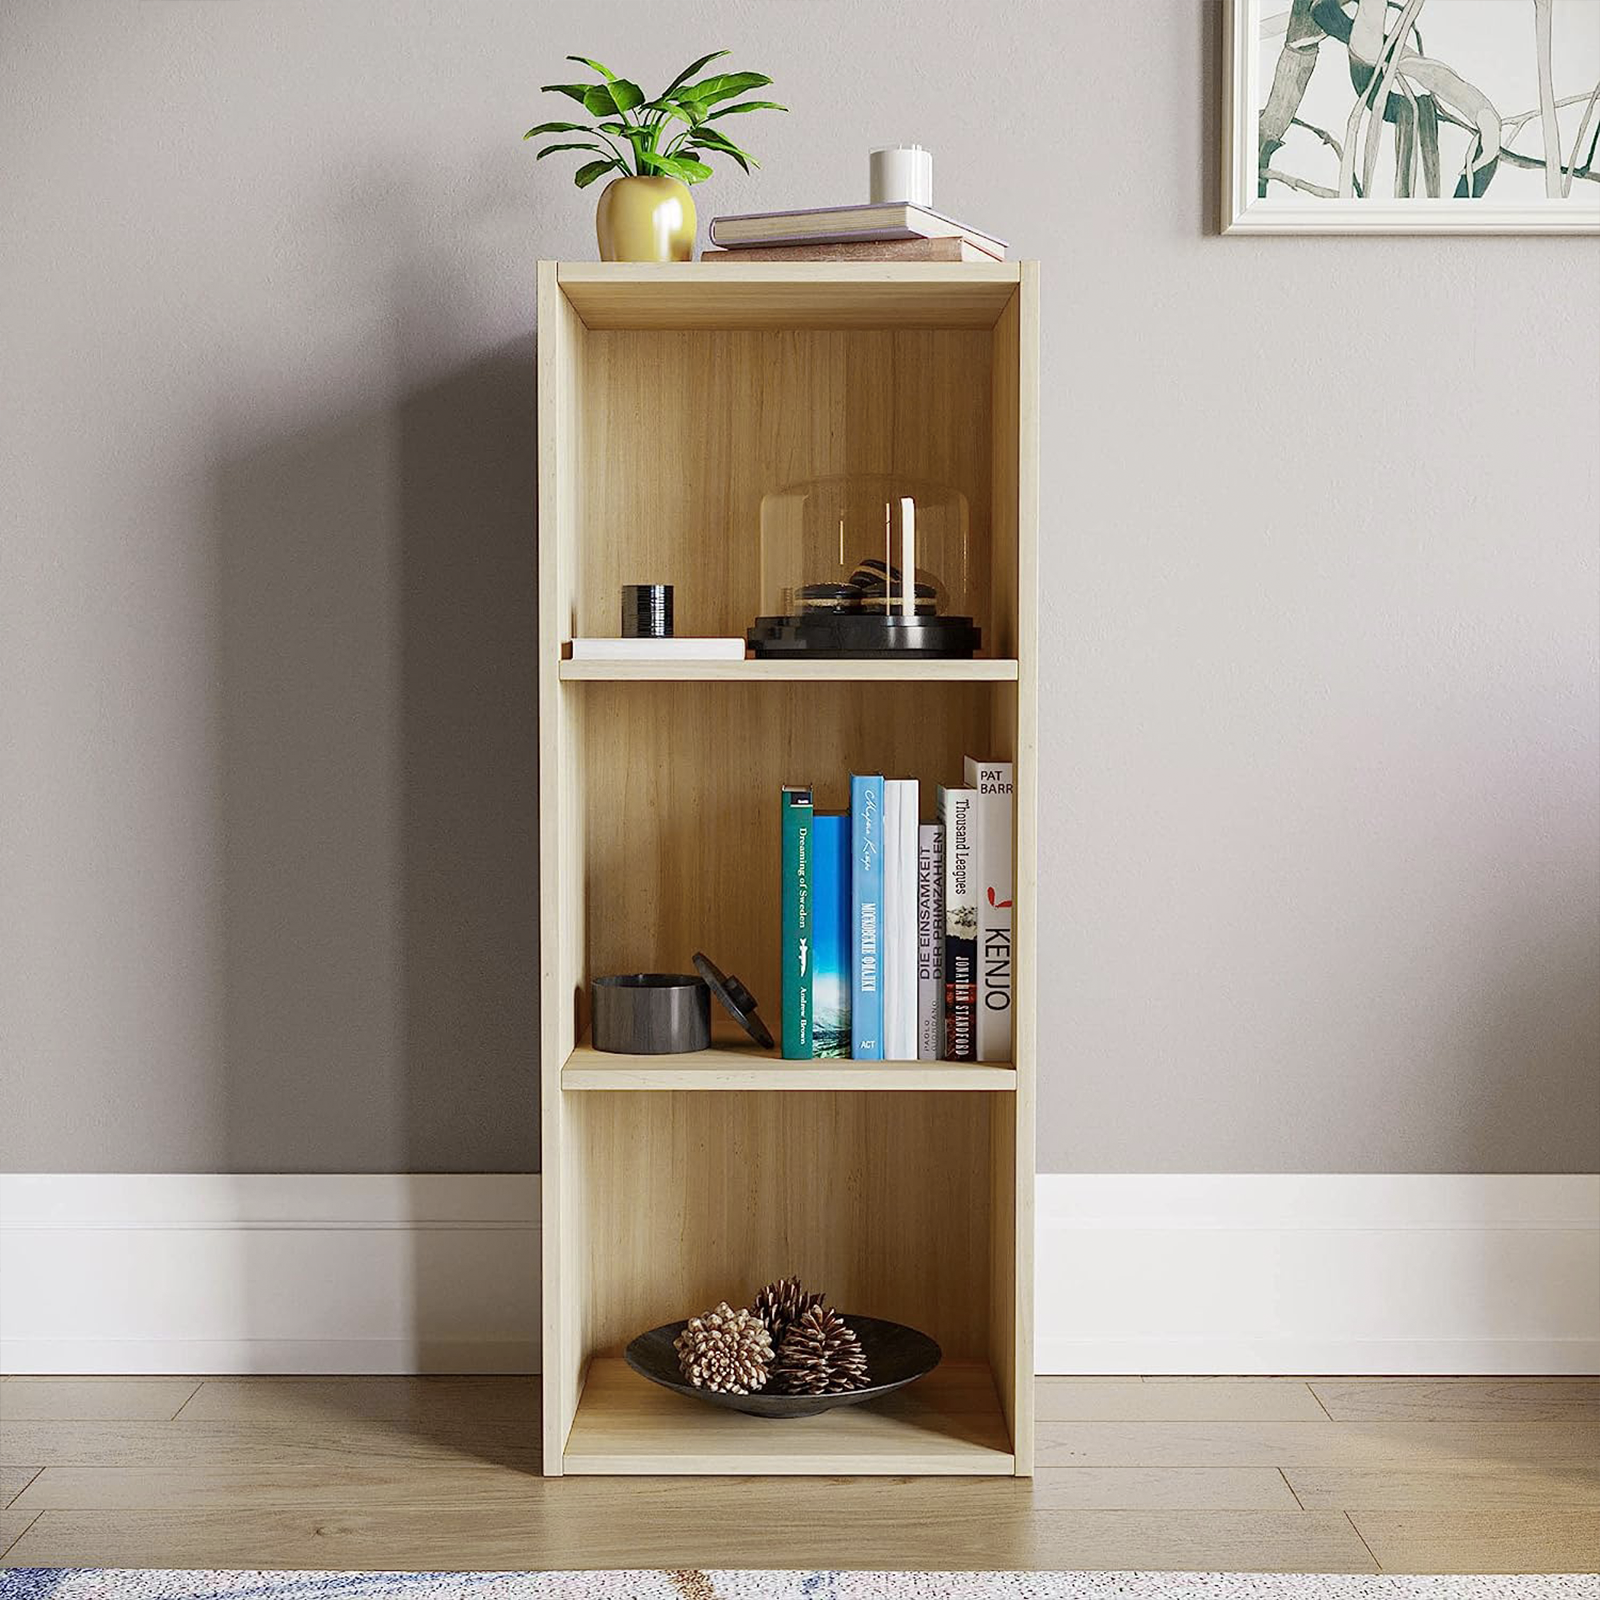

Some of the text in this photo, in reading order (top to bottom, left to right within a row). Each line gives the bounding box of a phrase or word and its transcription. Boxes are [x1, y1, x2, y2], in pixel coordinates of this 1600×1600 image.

[980, 770, 1003, 781] PAT
[980, 784, 1014, 794] BARR
[797, 828, 808, 929] Dreaming of Sweden
[954, 799, 970, 895] Thousand Leagues
[920, 846, 930, 980] DIE EINSAMKEIT
[933, 832, 943, 980] DER PRIMZAHLEN
[799, 986, 808, 1045] Andrew Brown
[955, 956, 969, 1056] JONATHAN STANDFORD
[985, 928, 1011, 1011] KENJO
